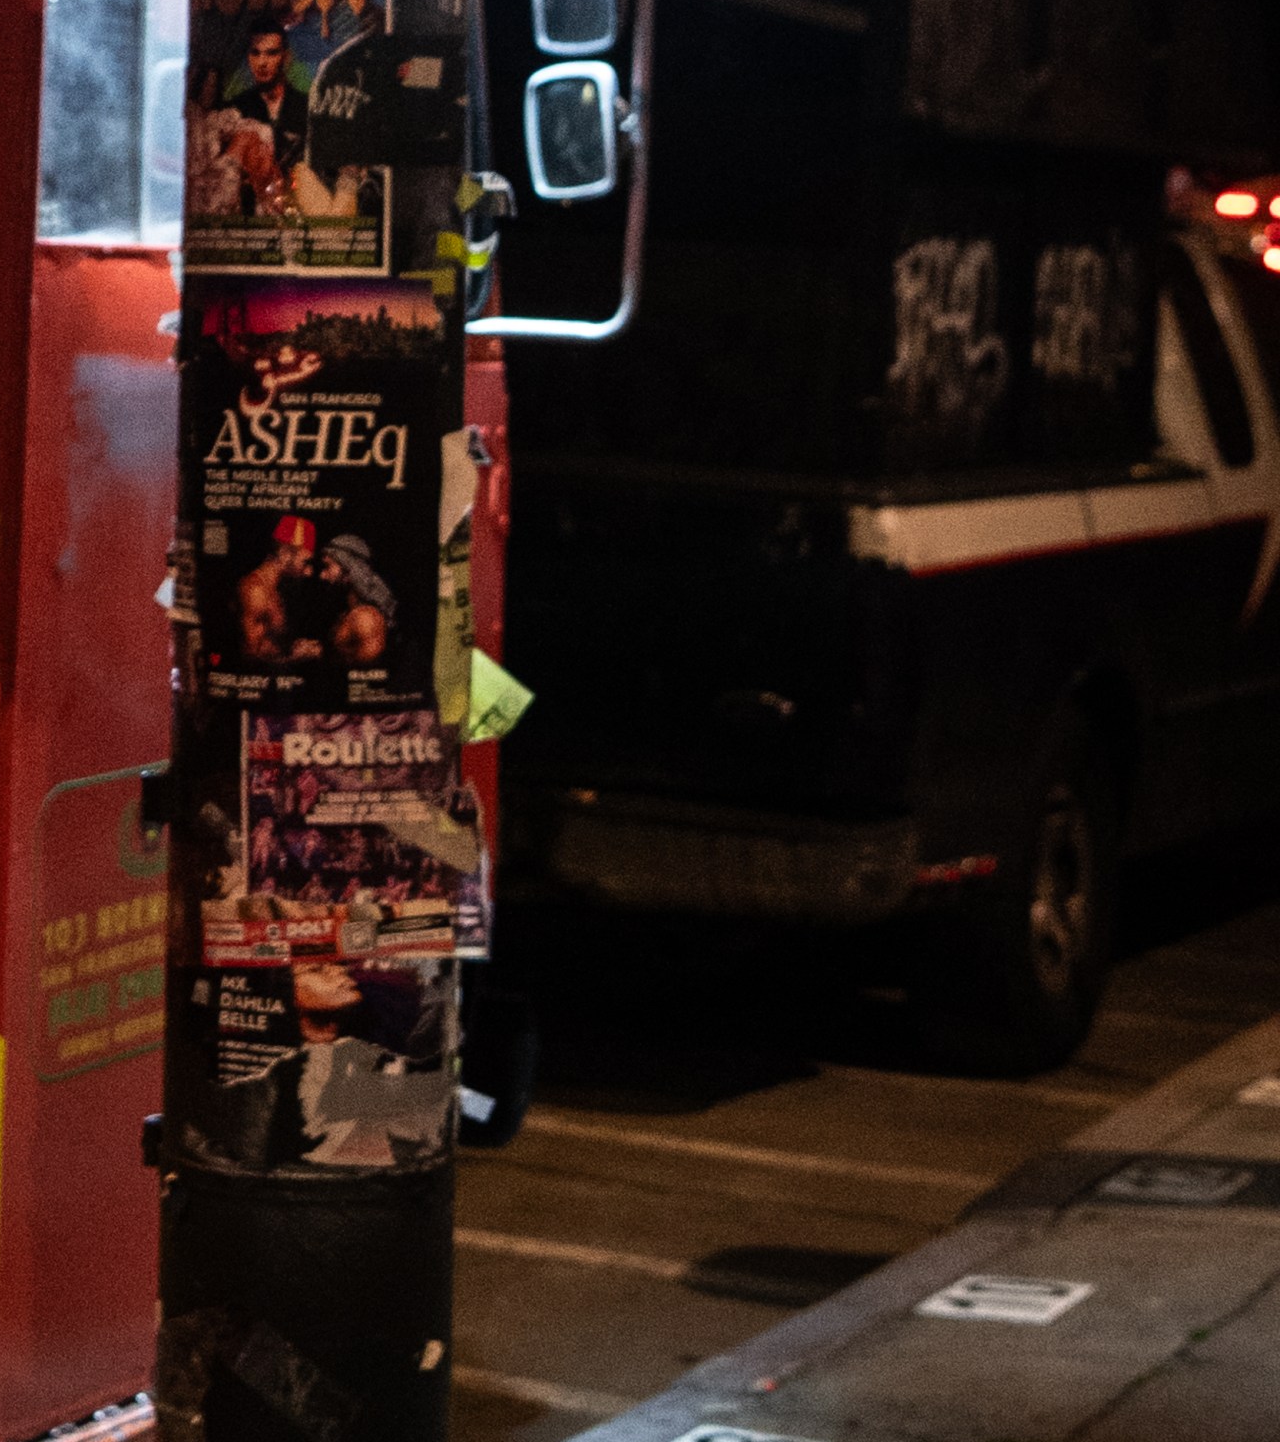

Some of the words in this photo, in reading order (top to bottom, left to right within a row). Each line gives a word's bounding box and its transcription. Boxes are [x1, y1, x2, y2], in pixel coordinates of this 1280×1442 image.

[280, 392, 307, 405] SAN
[311, 392, 383, 406] FRANCISCO
[202, 408, 410, 490] ASHEq
[205, 469, 228, 482] THE
[232, 470, 278, 482] MIDDLE
[204, 482, 247, 494] NORTH
[248, 496, 291, 510] DANCE
[296, 496, 343, 510] PARTY
[282, 731, 442, 766] Roulette
[218, 992, 286, 1013] DAHLIA
[217, 1012, 269, 1032] BELLE
